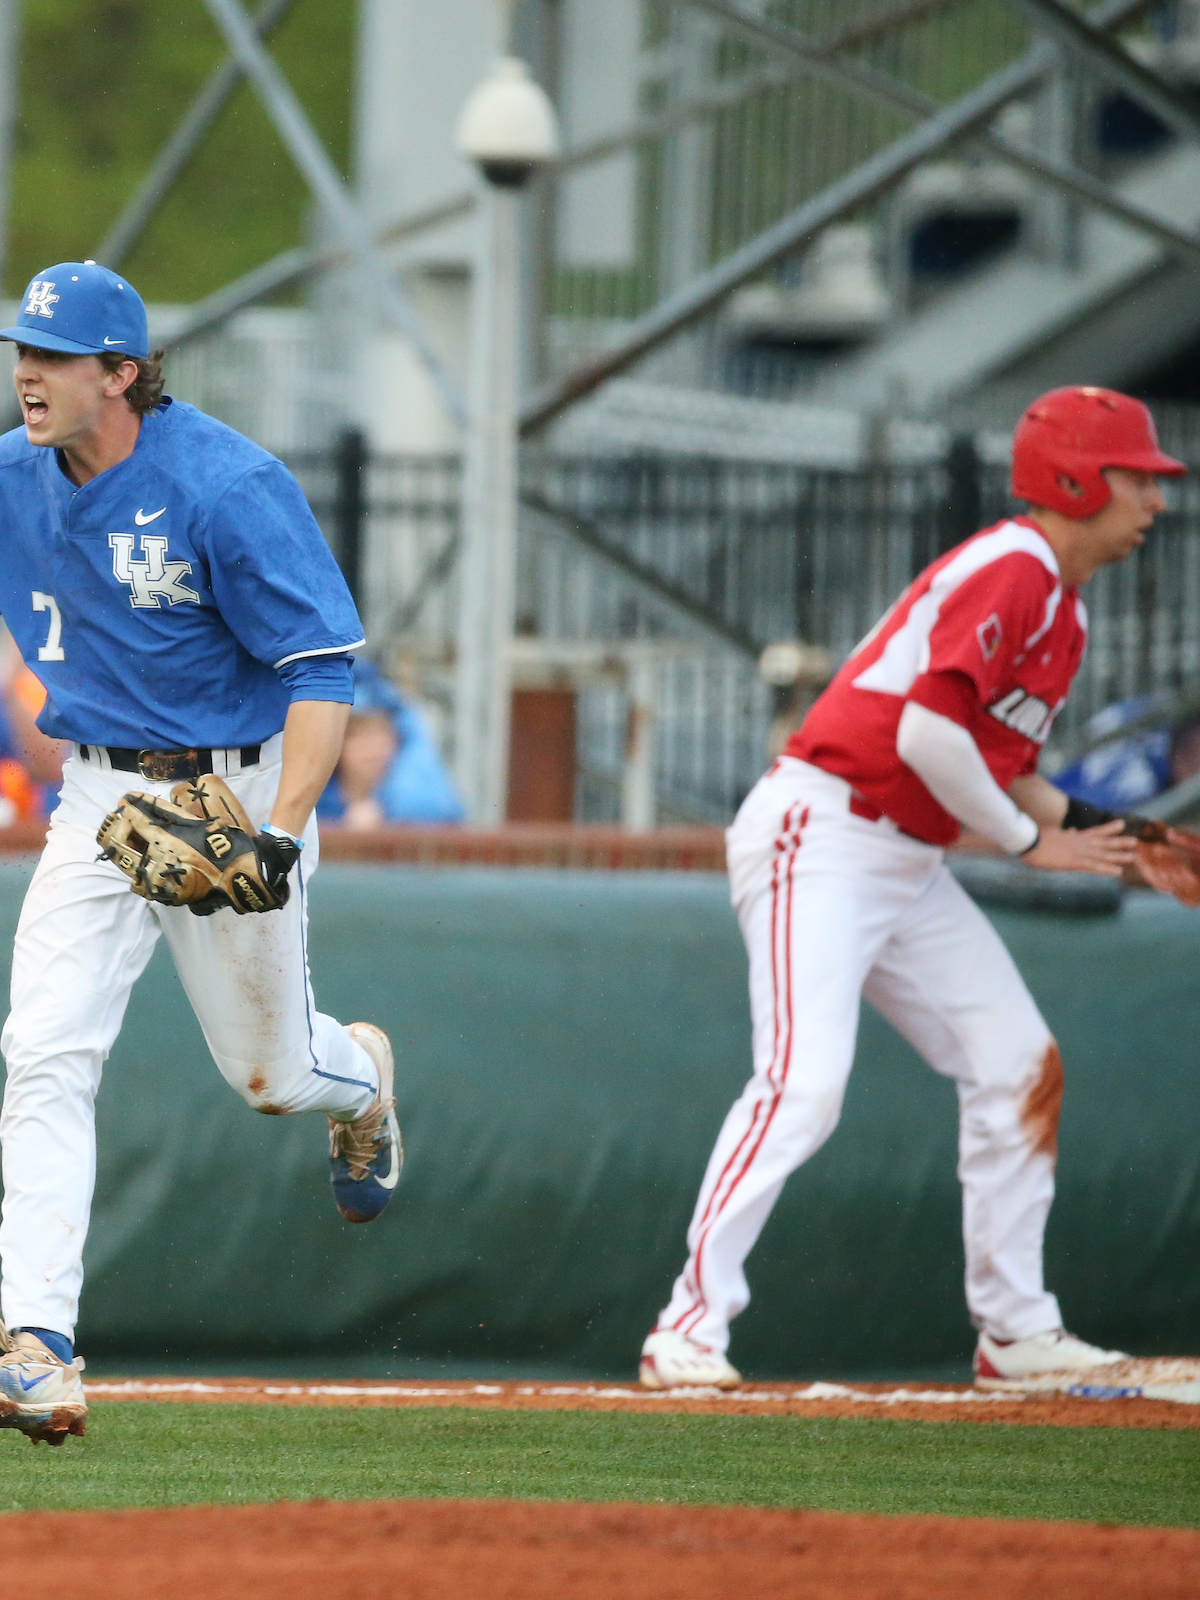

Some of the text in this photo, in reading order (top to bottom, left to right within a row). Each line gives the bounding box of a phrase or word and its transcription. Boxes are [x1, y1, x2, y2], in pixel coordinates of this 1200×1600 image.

[25, 280, 60, 319] UK
[108, 532, 201, 609] UK
[31, 590, 65, 661] 7
[234, 874, 265, 912] Wilson
